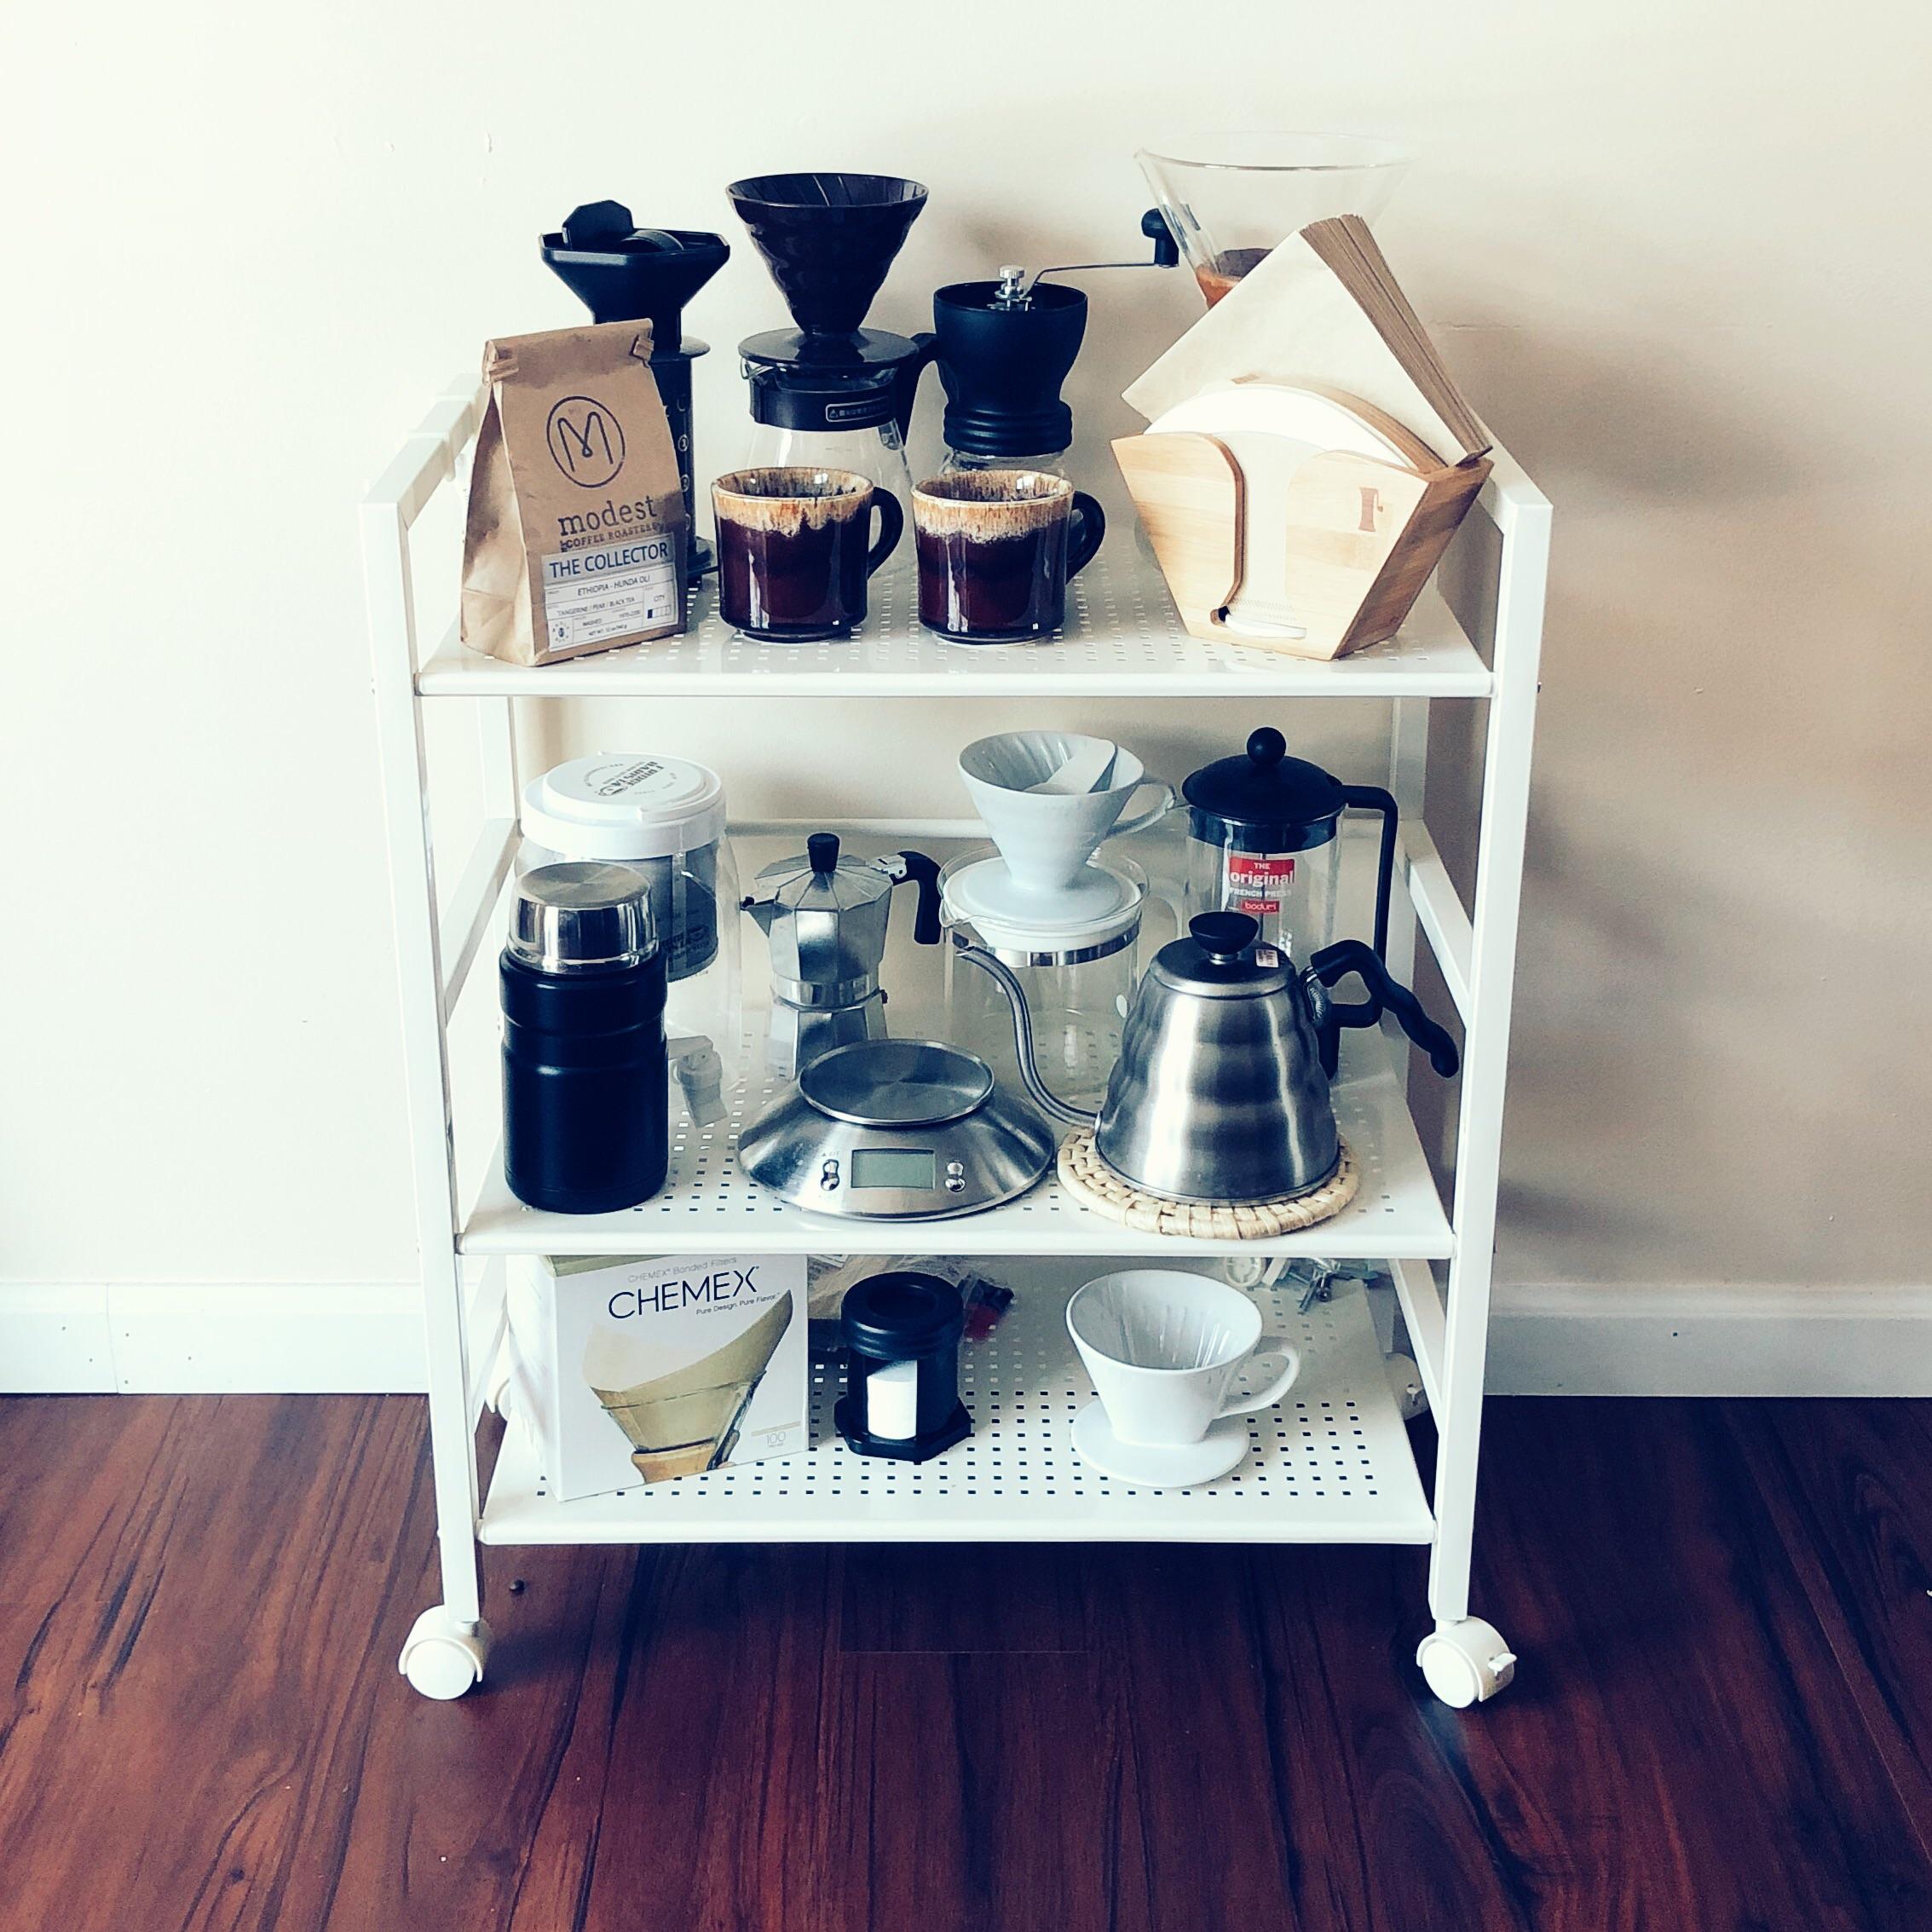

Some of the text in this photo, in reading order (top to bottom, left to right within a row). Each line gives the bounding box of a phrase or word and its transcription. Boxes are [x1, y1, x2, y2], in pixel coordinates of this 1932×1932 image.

[557, 495, 658, 537] modest
[566, 533, 605, 548] COFFEE
[550, 542, 669, 578] THE COLLECTOR
[577, 583, 609, 596] ETHIOPIA
[1230, 870, 1293, 888] original
[1228, 887, 1262, 897] FRENCH
[1244, 901, 1277, 910] bodum
[673, 1261, 708, 1276] Bonded
[711, 1257, 737, 1267] Filters
[695, 1306, 712, 1315] Pure
[740, 1298, 755, 1306] Pure
